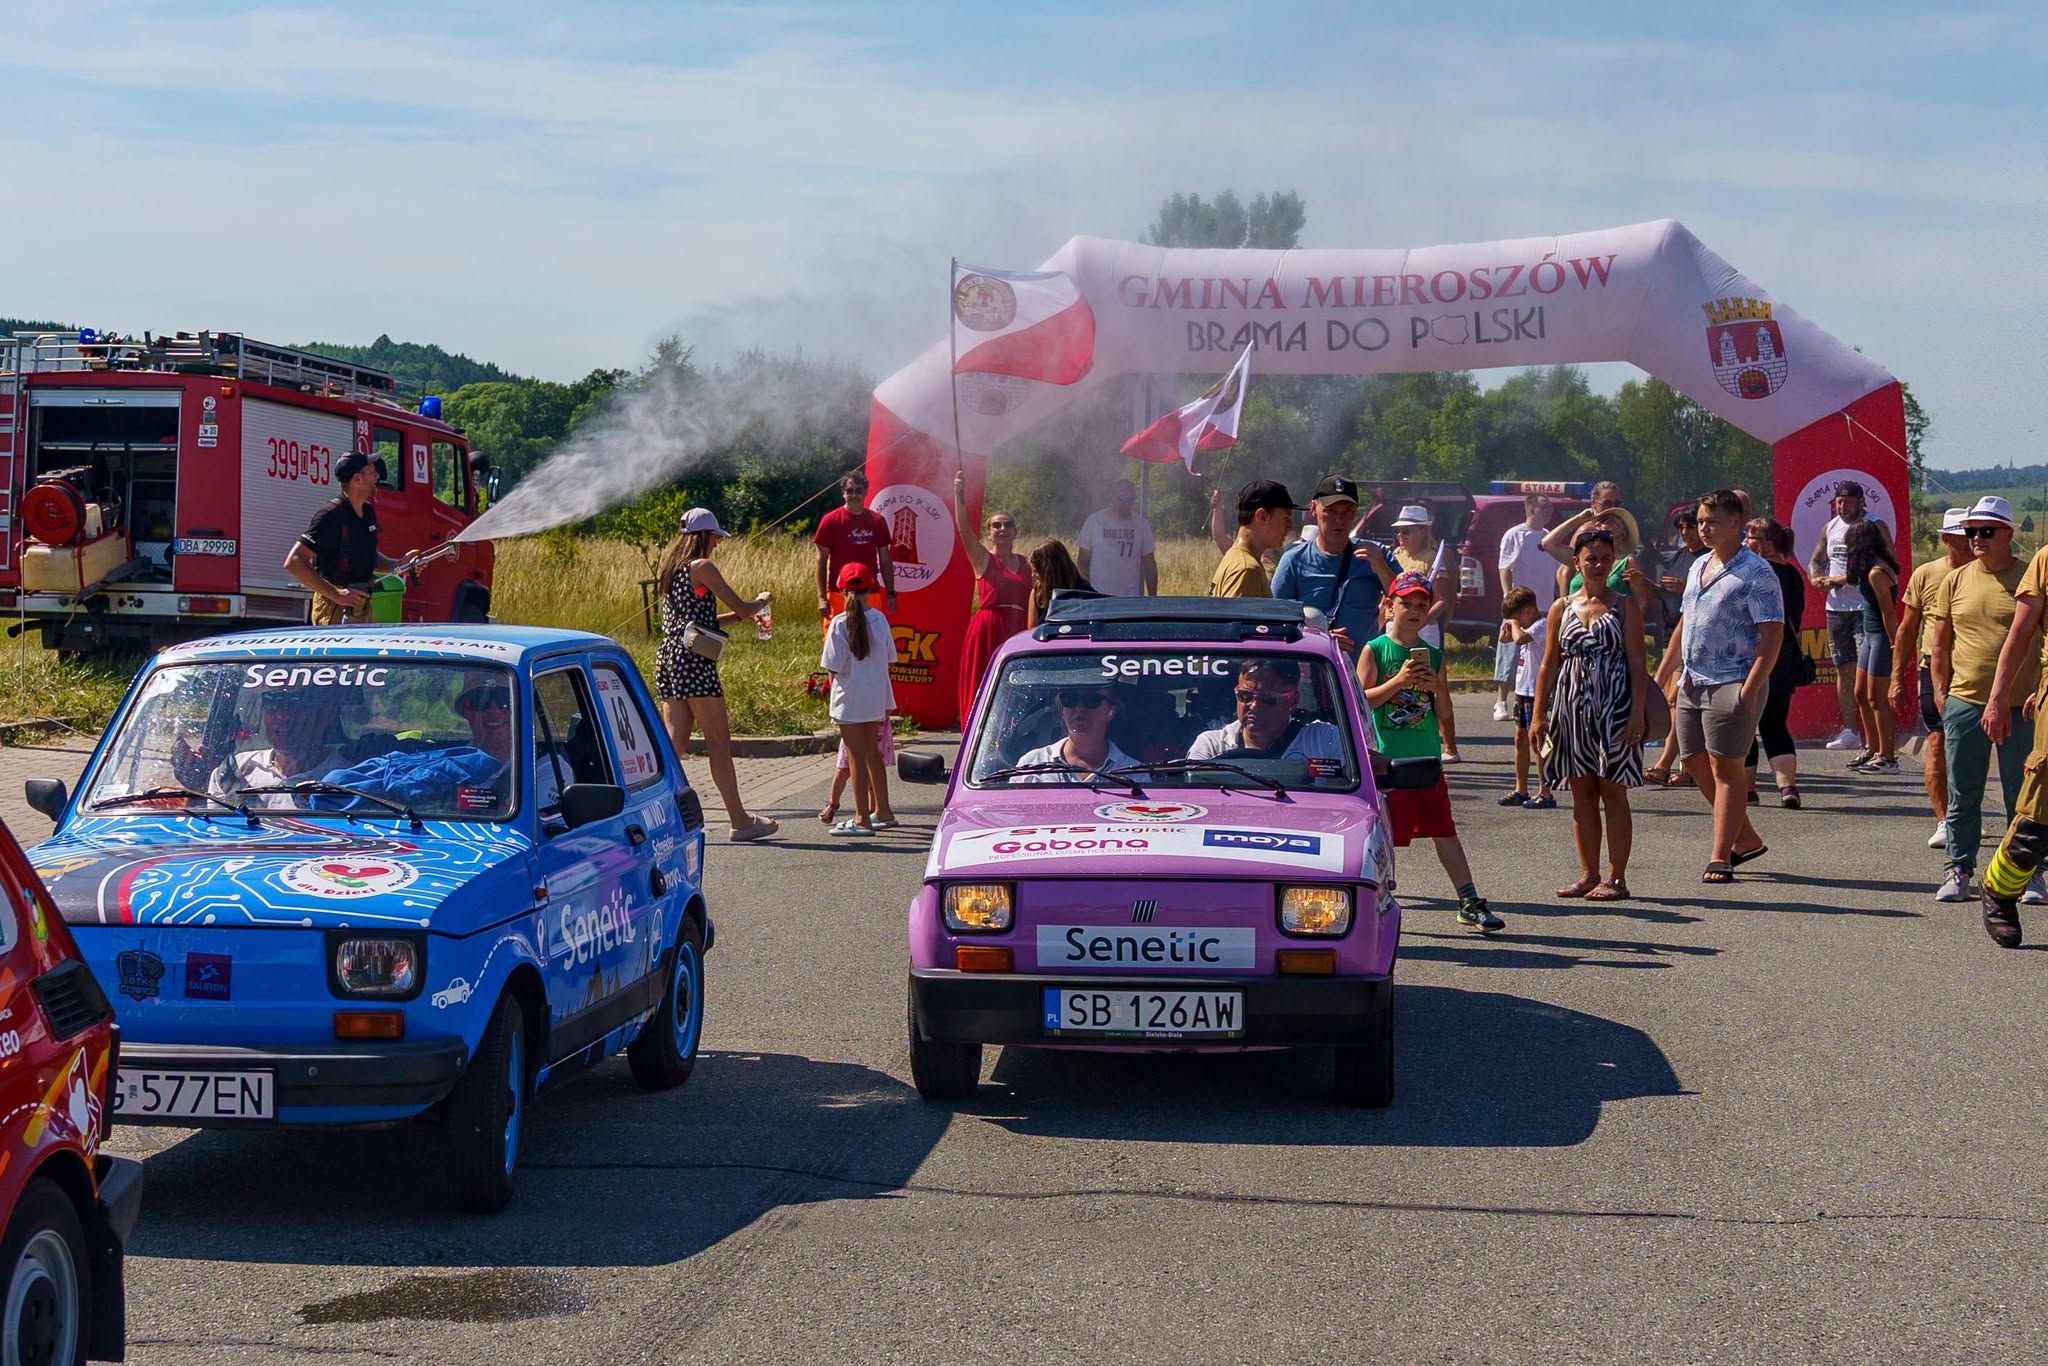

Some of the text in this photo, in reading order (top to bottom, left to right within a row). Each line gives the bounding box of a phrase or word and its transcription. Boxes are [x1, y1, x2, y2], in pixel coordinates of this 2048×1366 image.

[1117, 253, 1617, 310] GMINA MIEROSZÓW
[1187, 320, 1307, 352] BRAMA
[1327, 317, 1390, 352] DO
[900, 495, 913, 504] DO
[1805, 485, 1831, 509] BRAMA
[179, 539, 235, 553] DBA 29998
[1117, 541, 1133, 557] 77
[890, 625, 940, 664] CK
[243, 664, 388, 688] Senetic
[1101, 655, 1230, 677] Senetic
[890, 673, 934, 684] KULTURY
[610, 695, 636, 751] 48
[1009, 826, 1187, 836] STS Logistic
[1213, 832, 1312, 848] moya
[992, 838, 1150, 854] Gabona
[297, 881, 376, 897] dla Dzieci
[560, 886, 638, 971] Senetic
[1066, 927, 1221, 963] Senetic
[187, 981, 228, 993] TAURON
[1047, 993, 1235, 1029] PL SB 126AW
[142, 1073, 263, 1116] 577EN
